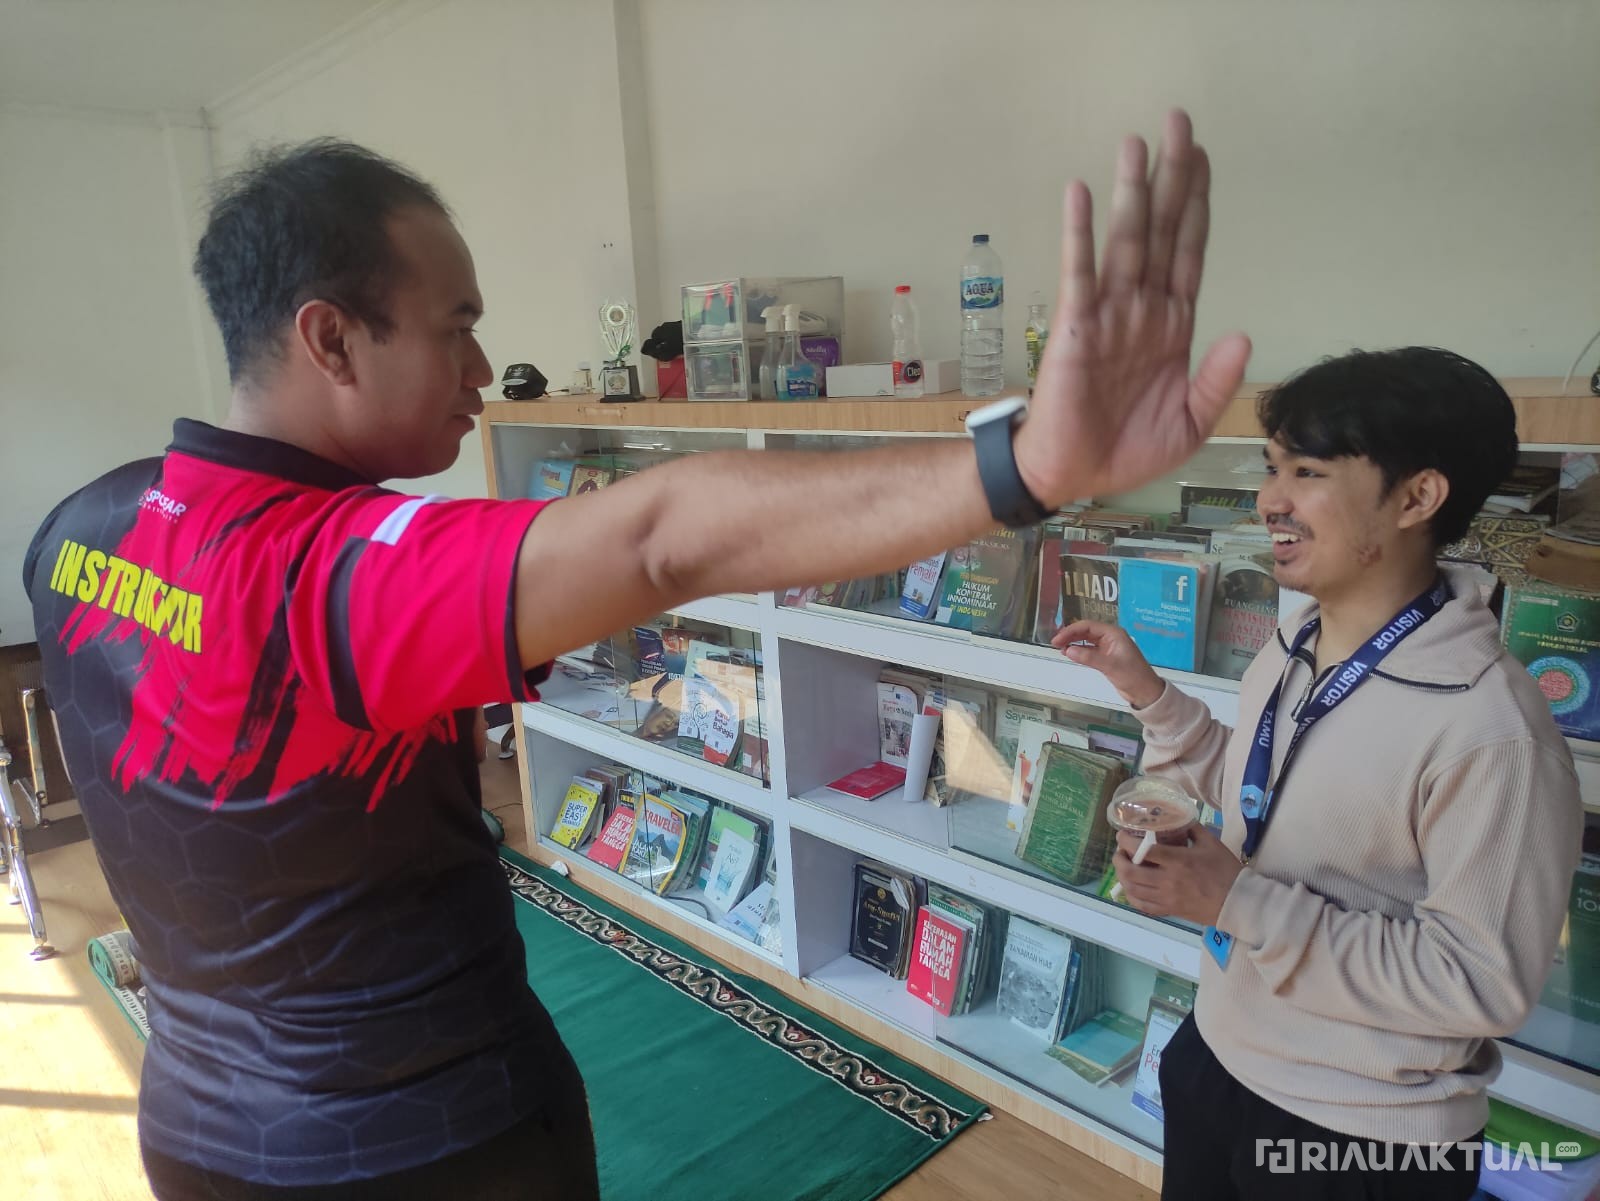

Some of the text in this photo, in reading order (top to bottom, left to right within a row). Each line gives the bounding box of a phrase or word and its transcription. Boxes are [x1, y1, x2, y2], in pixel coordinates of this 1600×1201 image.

[966, 283, 994, 296] AQUA
[956, 588, 992, 601] KONTRAK
[962, 580, 990, 592] HUKUM
[1064, 571, 1118, 602] ILIAD
[947, 594, 997, 610] INNOMINAAT
[1373, 608, 1425, 650] VISITOR
[1321, 660, 1368, 707] VISITOR
[712, 721, 734, 740] Bahagia
[1258, 710, 1274, 748] TAMU
[564, 810, 584, 822] EASY
[568, 802, 588, 813] SUPER
[643, 810, 680, 836] TRAVELER
[601, 834, 626, 852] TANGGA
[922, 927, 955, 956] DALAM
[923, 920, 957, 944] KEKERASAN
[918, 952, 950, 980] TANGGA
[920, 938, 954, 970] RUMAH
